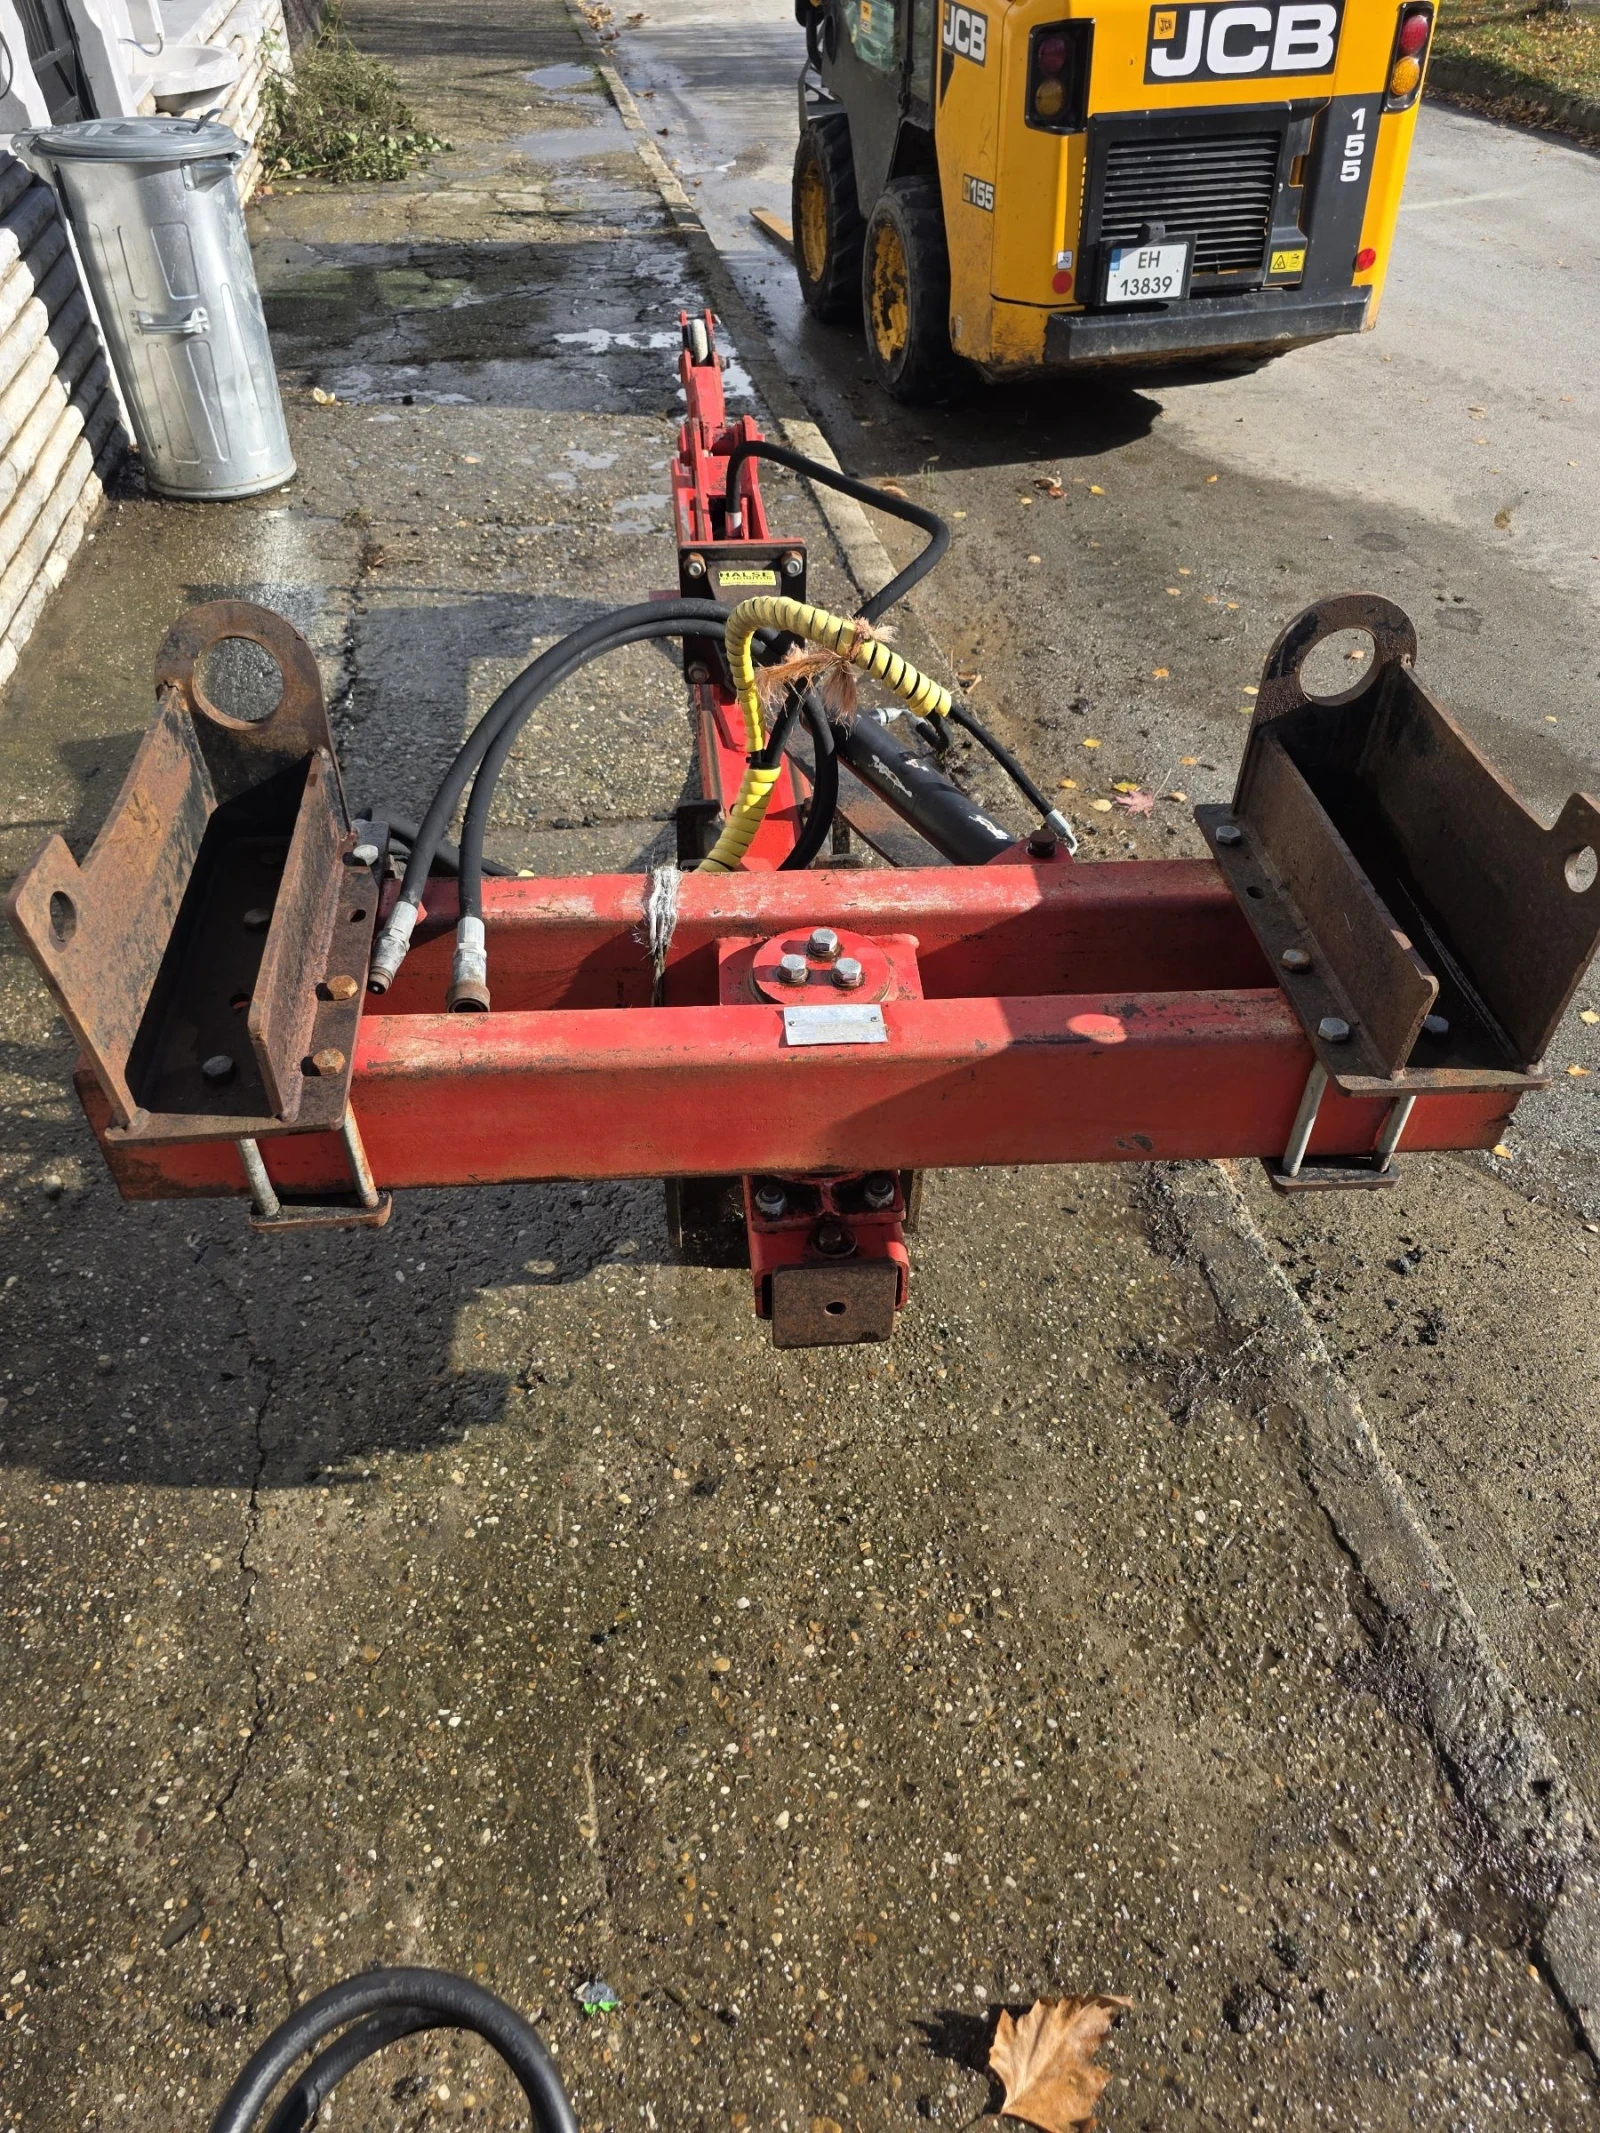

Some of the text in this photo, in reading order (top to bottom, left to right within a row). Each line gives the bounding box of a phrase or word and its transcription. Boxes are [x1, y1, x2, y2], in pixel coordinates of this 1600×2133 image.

[944, 5, 986, 61] JCB
[1151, 4, 1337, 77] JCB
[1160, 18, 1172, 32] JCB
[1340, 108, 1366, 182] 155
[971, 179, 994, 210] 155
[1138, 251, 1161, 269] EH
[1120, 276, 1172, 296] 13839
